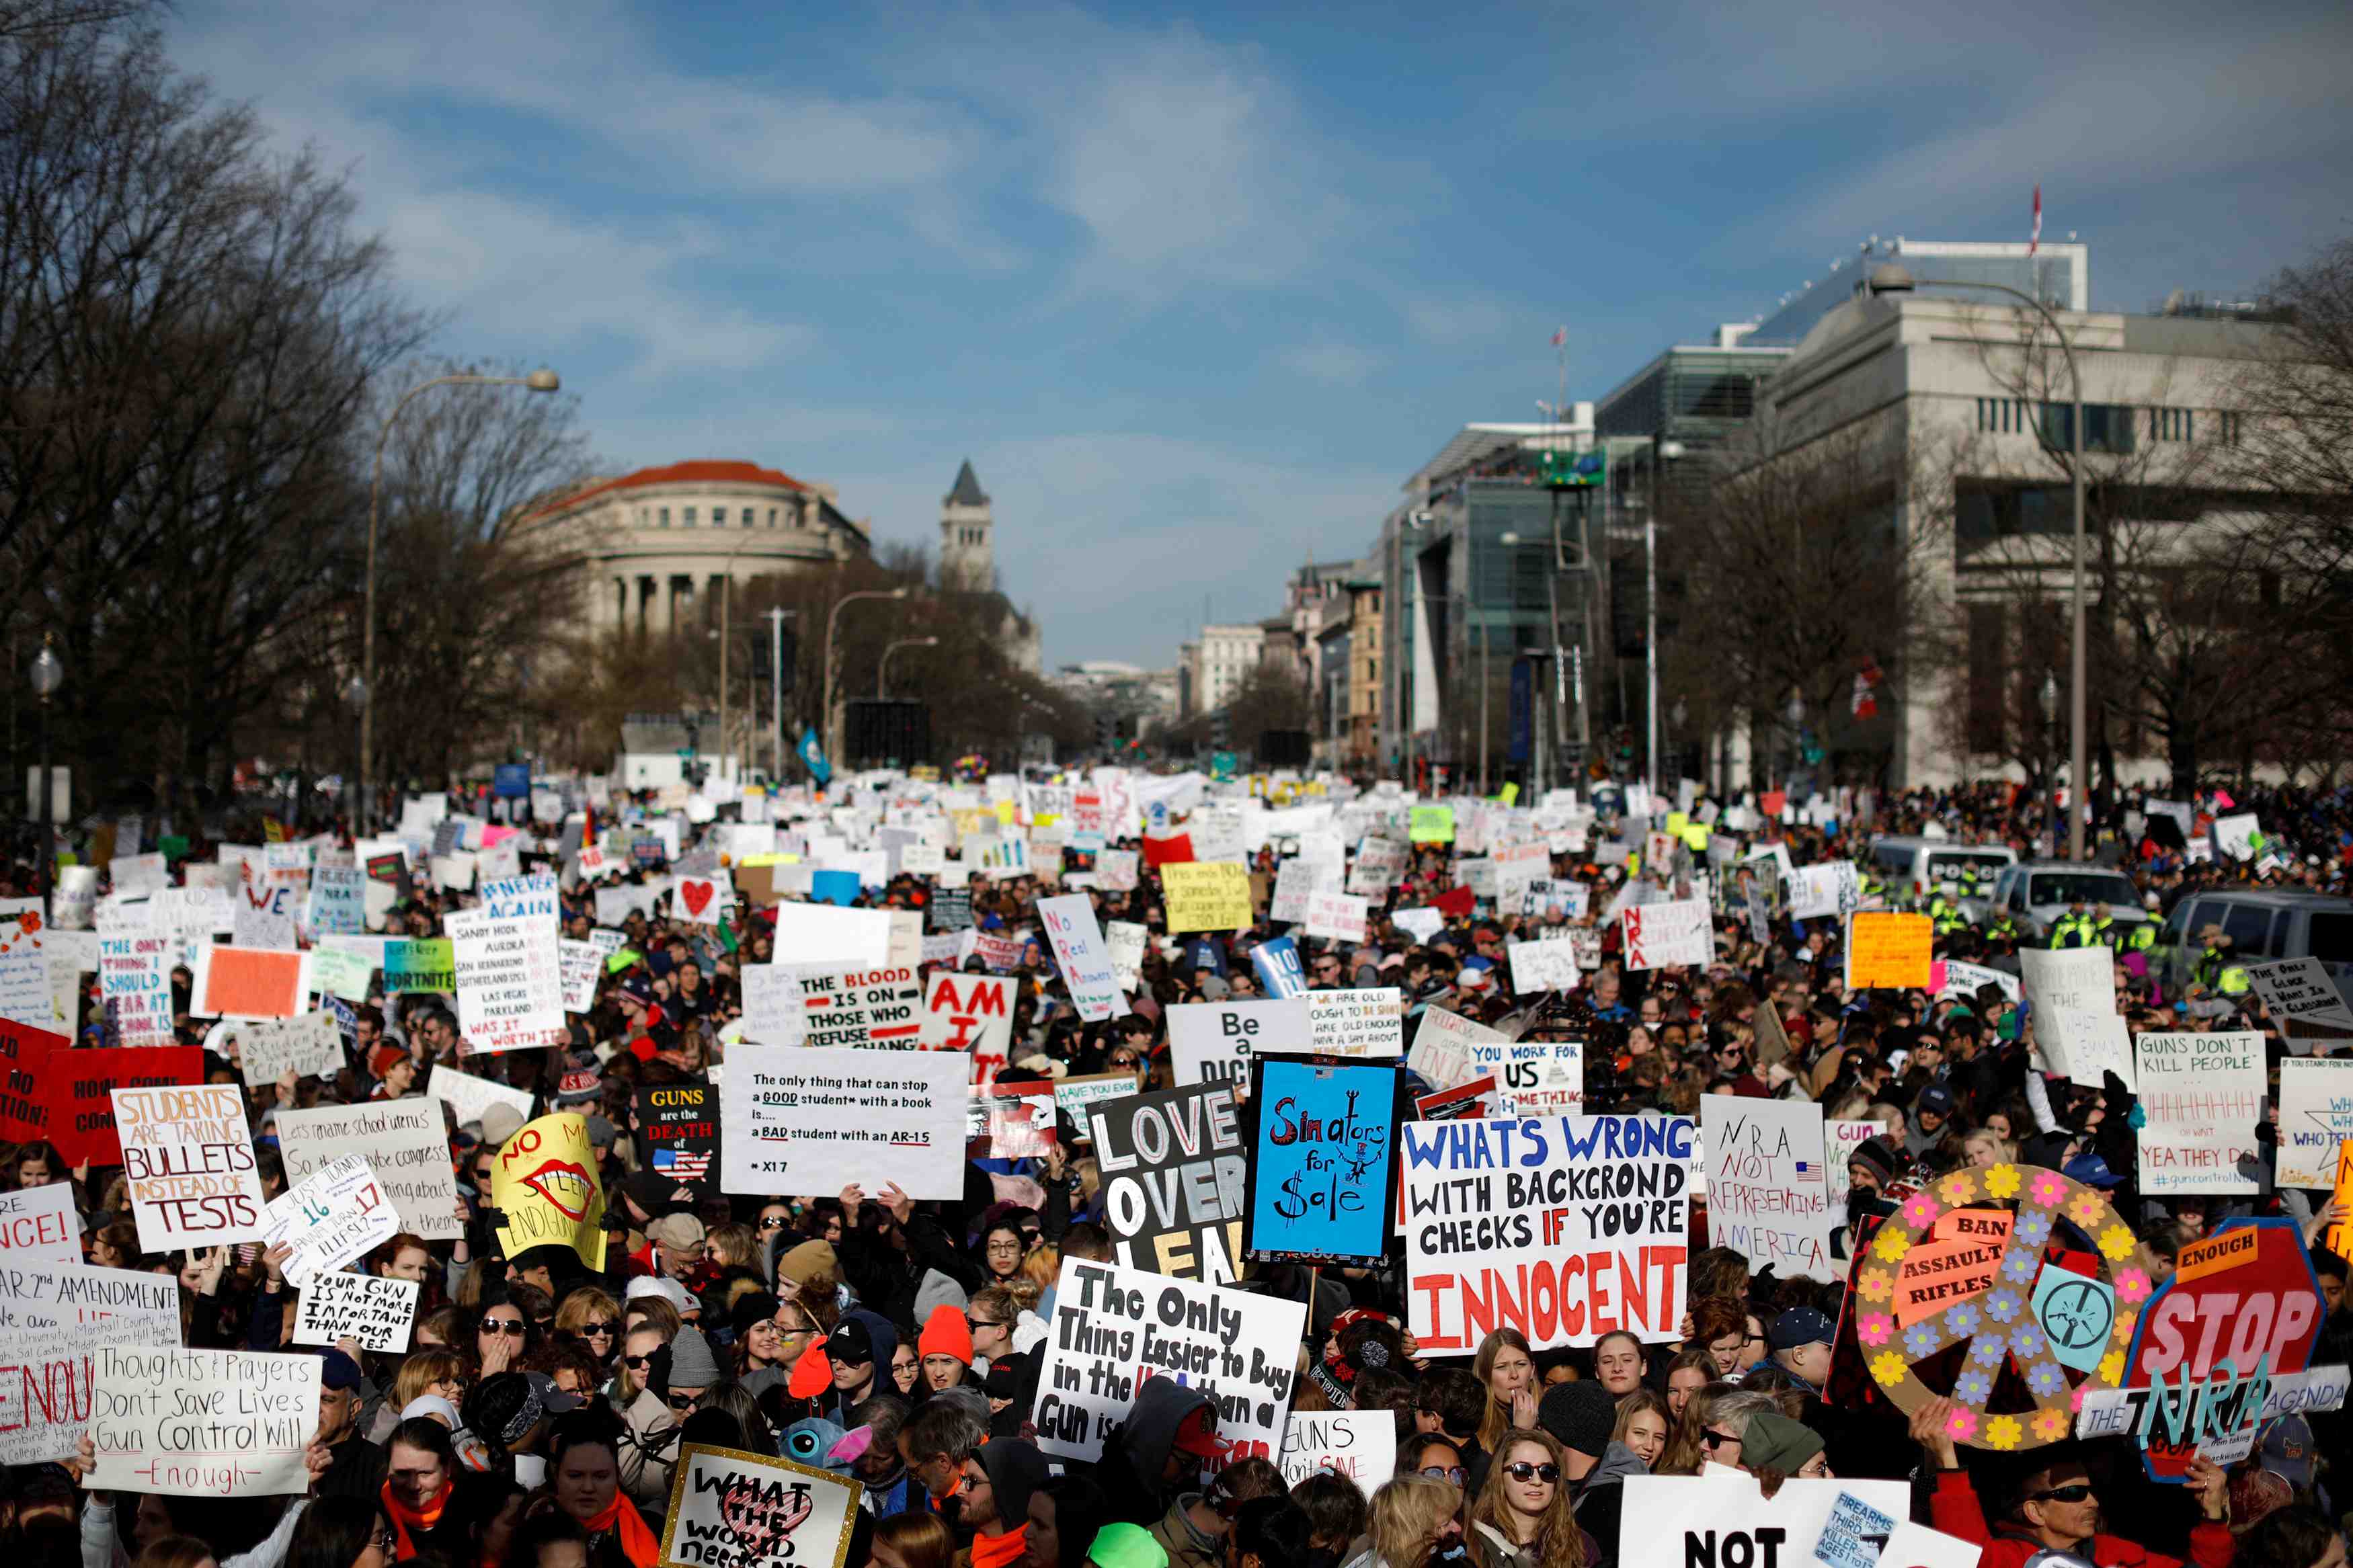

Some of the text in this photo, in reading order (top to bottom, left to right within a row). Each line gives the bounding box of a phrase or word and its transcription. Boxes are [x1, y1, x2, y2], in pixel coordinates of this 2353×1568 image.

[483, 875, 555, 899] #NEVER
[456, 925, 518, 940] SANDY HOOK
[101, 938, 167, 954] THE ONLY
[485, 939, 526, 954] AURORA
[104, 955, 159, 971] THING I
[104, 973, 160, 994] SHOULD
[385, 971, 452, 989] FORTNITE
[800, 967, 911, 994] THE BLOOD
[150, 993, 169, 1012] AT
[481, 991, 501, 1003] LAS
[834, 987, 895, 1007] IS ON
[930, 978, 1006, 1018] AM
[1337, 992, 1358, 1004] ARE
[1362, 992, 1386, 1002] OLD
[157, 1015, 173, 1032] IS
[807, 1005, 911, 1029] THOSE WHO
[1222, 1012, 1259, 1036] Be
[1347, 1007, 1361, 1018] TO
[470, 1021, 499, 1035] WAS
[491, 1031, 536, 1046] WORTH
[807, 1028, 869, 1047] REFUSE
[945, 1017, 978, 1048] I
[1315, 1018, 1400, 1034] ARE OLD ENOUGH
[1236, 1038, 1250, 1055] a
[1472, 1046, 1578, 1062] YOU WORK FOR
[2196, 1036, 2251, 1055] DON'T
[1505, 1061, 1539, 1088] US
[2143, 1057, 2182, 1073] KILL
[753, 1074, 928, 1093] The only thing that can stop
[1055, 1081, 1135, 1103] HAVE YOU EVER
[118, 1089, 242, 1124] STUDENTS
[650, 1089, 704, 1107] GUNS
[762, 1091, 932, 1108] GOOD with a book
[354, 1110, 388, 1137] school
[660, 1110, 698, 1121] are the
[130, 1118, 243, 1145] ARE TAKING
[647, 1122, 713, 1141] DEATH
[674, 1138, 686, 1149] of
[762, 1126, 930, 1145] BAD student with an AR-15
[1090, 1088, 1240, 1173] LOVE
[1403, 1116, 1695, 1170] WHAT'S WRONG
[2294, 1132, 2324, 1147] WHO
[124, 1143, 254, 1180] BULLETS
[288, 1144, 450, 1177] So congress
[502, 1130, 541, 1173] NO
[1306, 1150, 1335, 1173] for
[2140, 1145, 2221, 1168] YEA THEY
[762, 1161, 788, 1173] X17
[1720, 1147, 1778, 1184] NOT
[133, 1174, 245, 1202] INSTEAD OF
[415, 1178, 452, 1200] about
[1107, 1155, 1246, 1237] OVER
[1273, 1169, 1365, 1229] $ale
[1410, 1163, 1685, 1218] WITH BACKGROND
[1707, 1178, 1827, 1221] REPRESENTING
[145, 1194, 257, 1233] TESTS
[303, 1198, 330, 1227] 16
[354, 1182, 381, 1216] 17
[1420, 1200, 1684, 1255] CHECKS IF YOU'RE
[1957, 1217, 2008, 1237] BAN
[1716, 1223, 1825, 1270] AMERICA
[2182, 1234, 2254, 1268] ENOUGH
[1904, 1244, 2003, 1278] ASSAULT
[313, 1272, 407, 1299] YOUR GUN
[1413, 1245, 1687, 1349] INNOCENT
[1909, 1274, 1993, 1305] RIFLES
[310, 1285, 413, 1314] IS NOT MORE
[1074, 1264, 1242, 1346] The Only
[305, 1302, 410, 1325] IMPORTANT
[305, 1319, 393, 1339] THAN OUR
[327, 1332, 389, 1350] LVES
[2142, 1290, 2317, 1378] STOP
[1058, 1305, 1135, 1362] Thing
[1142, 1323, 1217, 1374] Easier
[1221, 1346, 1244, 1378] to
[1249, 1347, 1291, 1401] Buy
[99, 1347, 309, 1391] Thoughts Prayers
[95, 1387, 304, 1418] Don't Save Lives
[1053, 1358, 1081, 1393] in
[1088, 1359, 1131, 1403] the
[1257, 1402, 1275, 1430] a
[2090, 1408, 2126, 1432] THE
[2141, 1352, 2269, 1450] NRA
[2264, 1385, 2346, 1413] AGENDA
[1037, 1393, 1090, 1444] Gun
[97, 1416, 301, 1452] Gun Control Will
[1281, 1416, 1355, 1452] GUNS
[2229, 1435, 2251, 1446] taking
[1320, 1454, 1367, 1479] SAVE
[695, 1468, 811, 1514] WHAT
[729, 1502, 788, 1533] THE
[1831, 1510, 1862, 1536] THIRD
[1837, 1493, 1895, 1532] FIREARMS
[1850, 1514, 1880, 1534] ARE THE
[686, 1520, 795, 1559] WORLD
[1823, 1526, 1859, 1553] KILLER
[1833, 1524, 1859, 1542] LEADING
[1683, 1527, 1786, 1568] NOT
[1818, 1538, 1862, 1567] AGES TO
